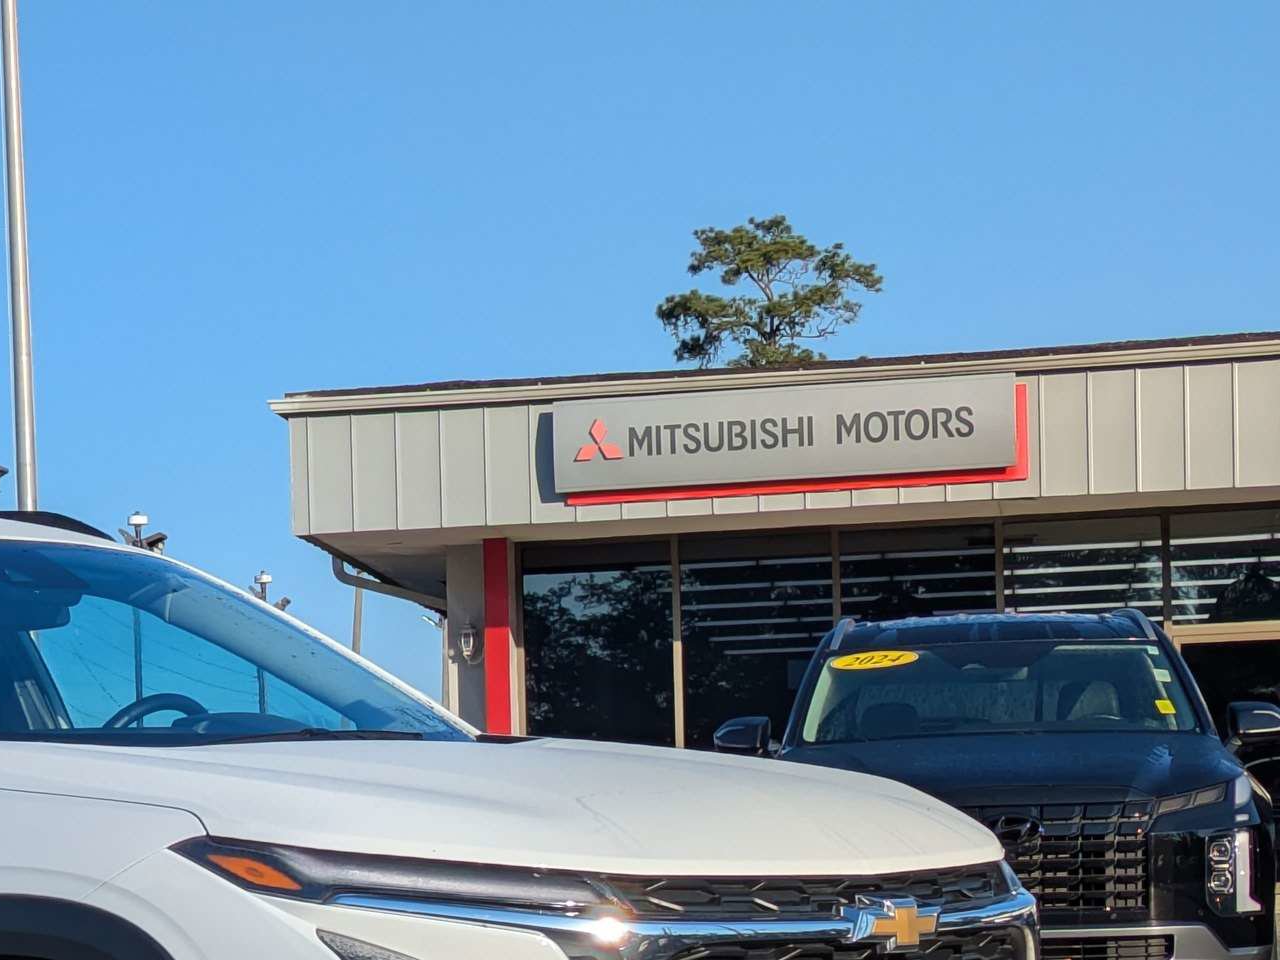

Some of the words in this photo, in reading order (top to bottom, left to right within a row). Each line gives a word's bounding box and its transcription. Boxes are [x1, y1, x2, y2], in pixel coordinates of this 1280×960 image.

[628, 415, 814, 457] MITSUBISHI
[836, 406, 975, 445] MOTORS
[843, 654, 903, 666] 2024
